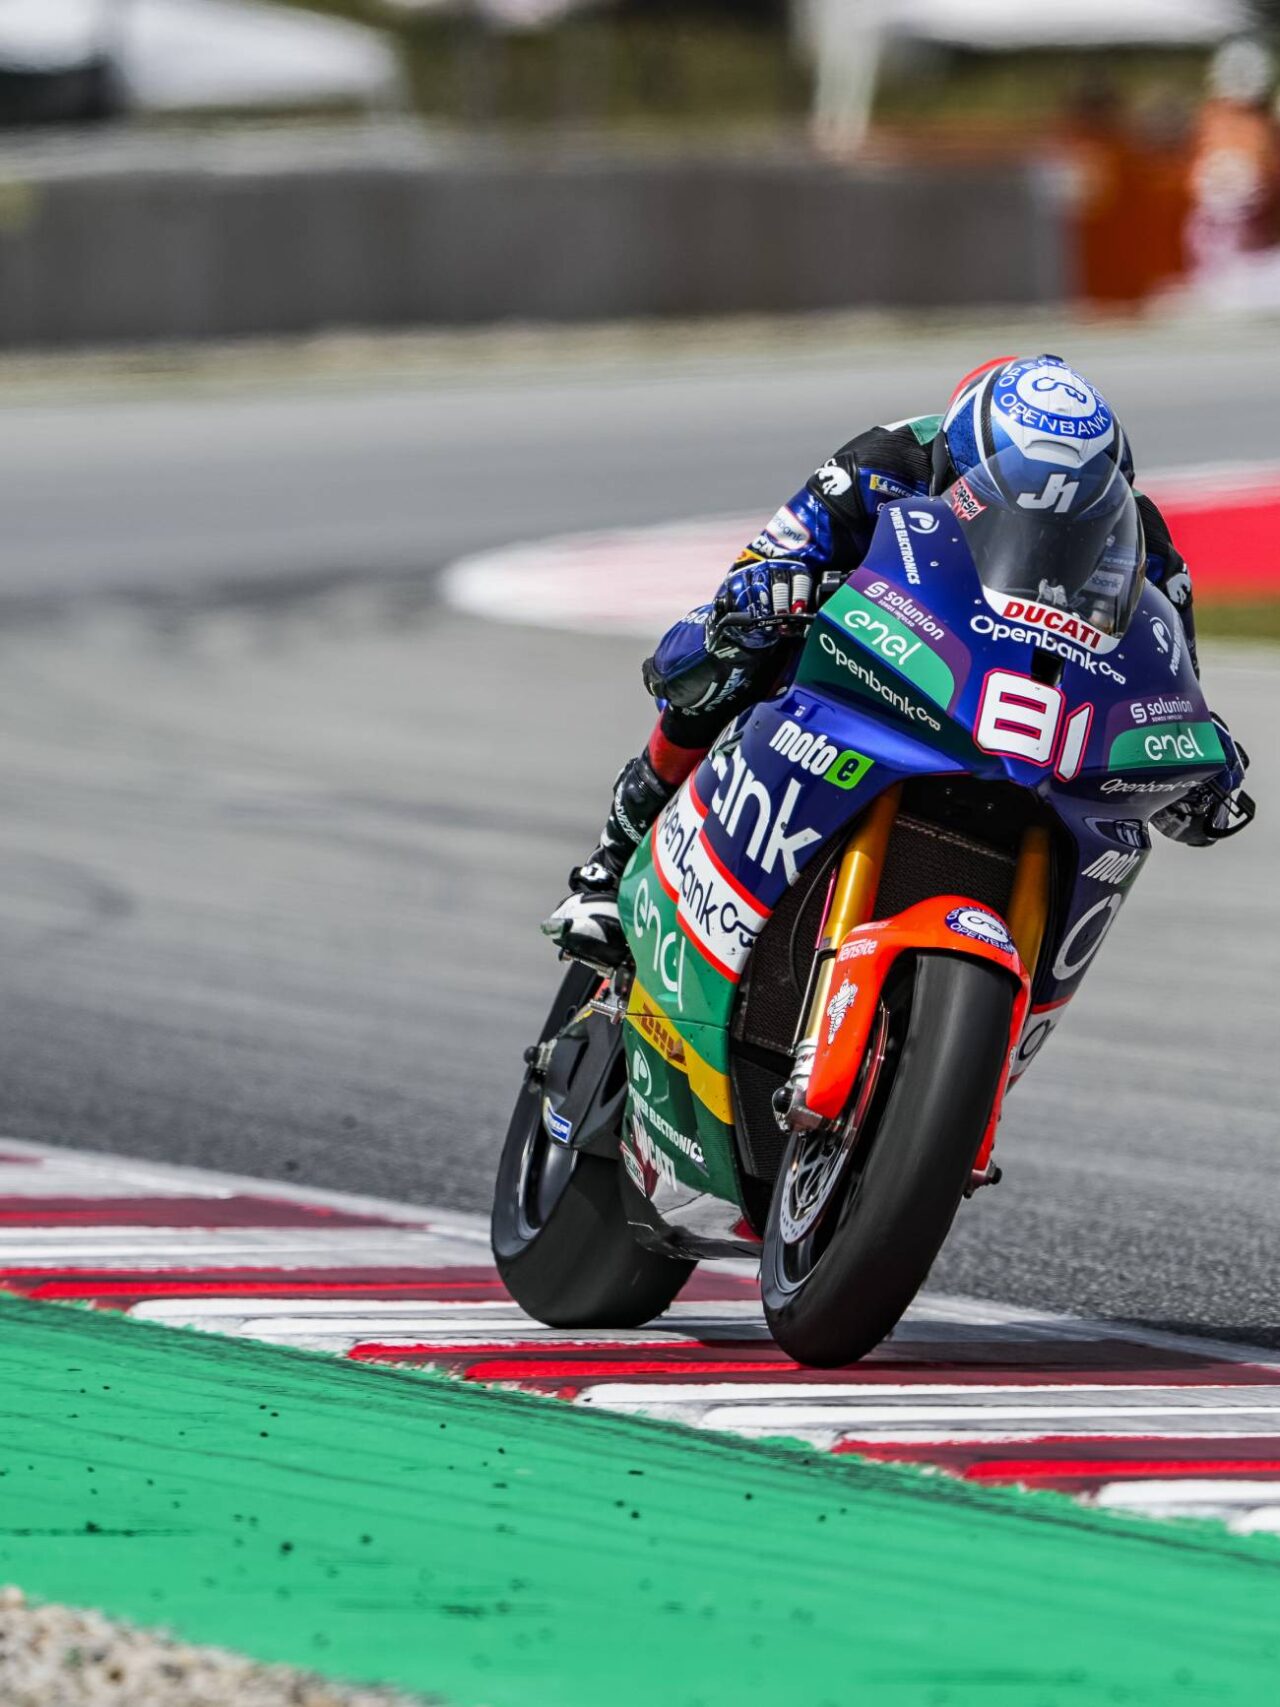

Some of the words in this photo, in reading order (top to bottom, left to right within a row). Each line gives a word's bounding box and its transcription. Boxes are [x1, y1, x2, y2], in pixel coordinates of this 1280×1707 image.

[1000, 393, 1108, 436] OPENBANK
[844, 610, 922, 666] enel
[883, 591, 945, 641] solunion
[1003, 601, 1102, 649] DUCATI
[970, 615, 1098, 675] Openbank
[819, 633, 916, 720] Openbank
[972, 667, 1094, 783] 81
[1146, 696, 1193, 716] solunion
[1144, 728, 1205, 761] enel
[649, 1106, 705, 1163] ELECTRONICS
